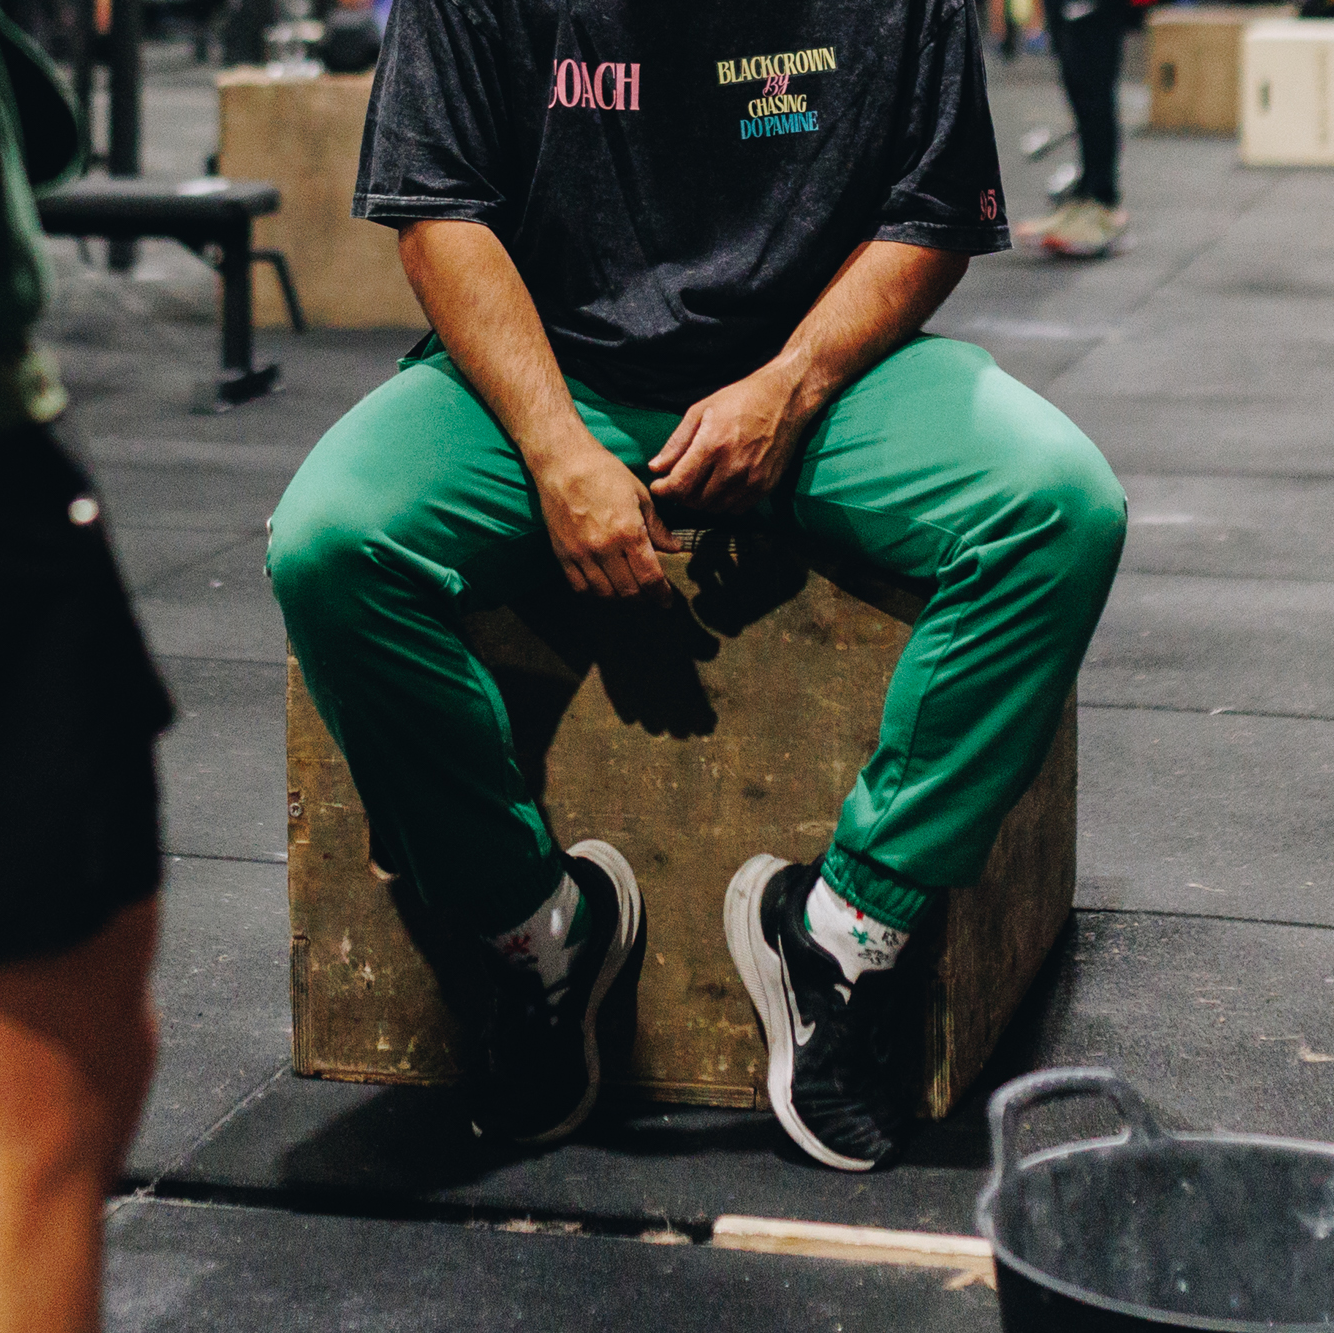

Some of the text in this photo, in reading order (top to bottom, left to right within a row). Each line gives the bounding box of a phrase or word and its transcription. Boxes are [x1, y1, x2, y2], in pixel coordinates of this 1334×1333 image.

[717, 47, 836, 85] BLACKCROWN
[762, 74, 790, 97] By
[748, 95, 807, 118] CHASING
[740, 111, 819, 140] DOPAMINE
